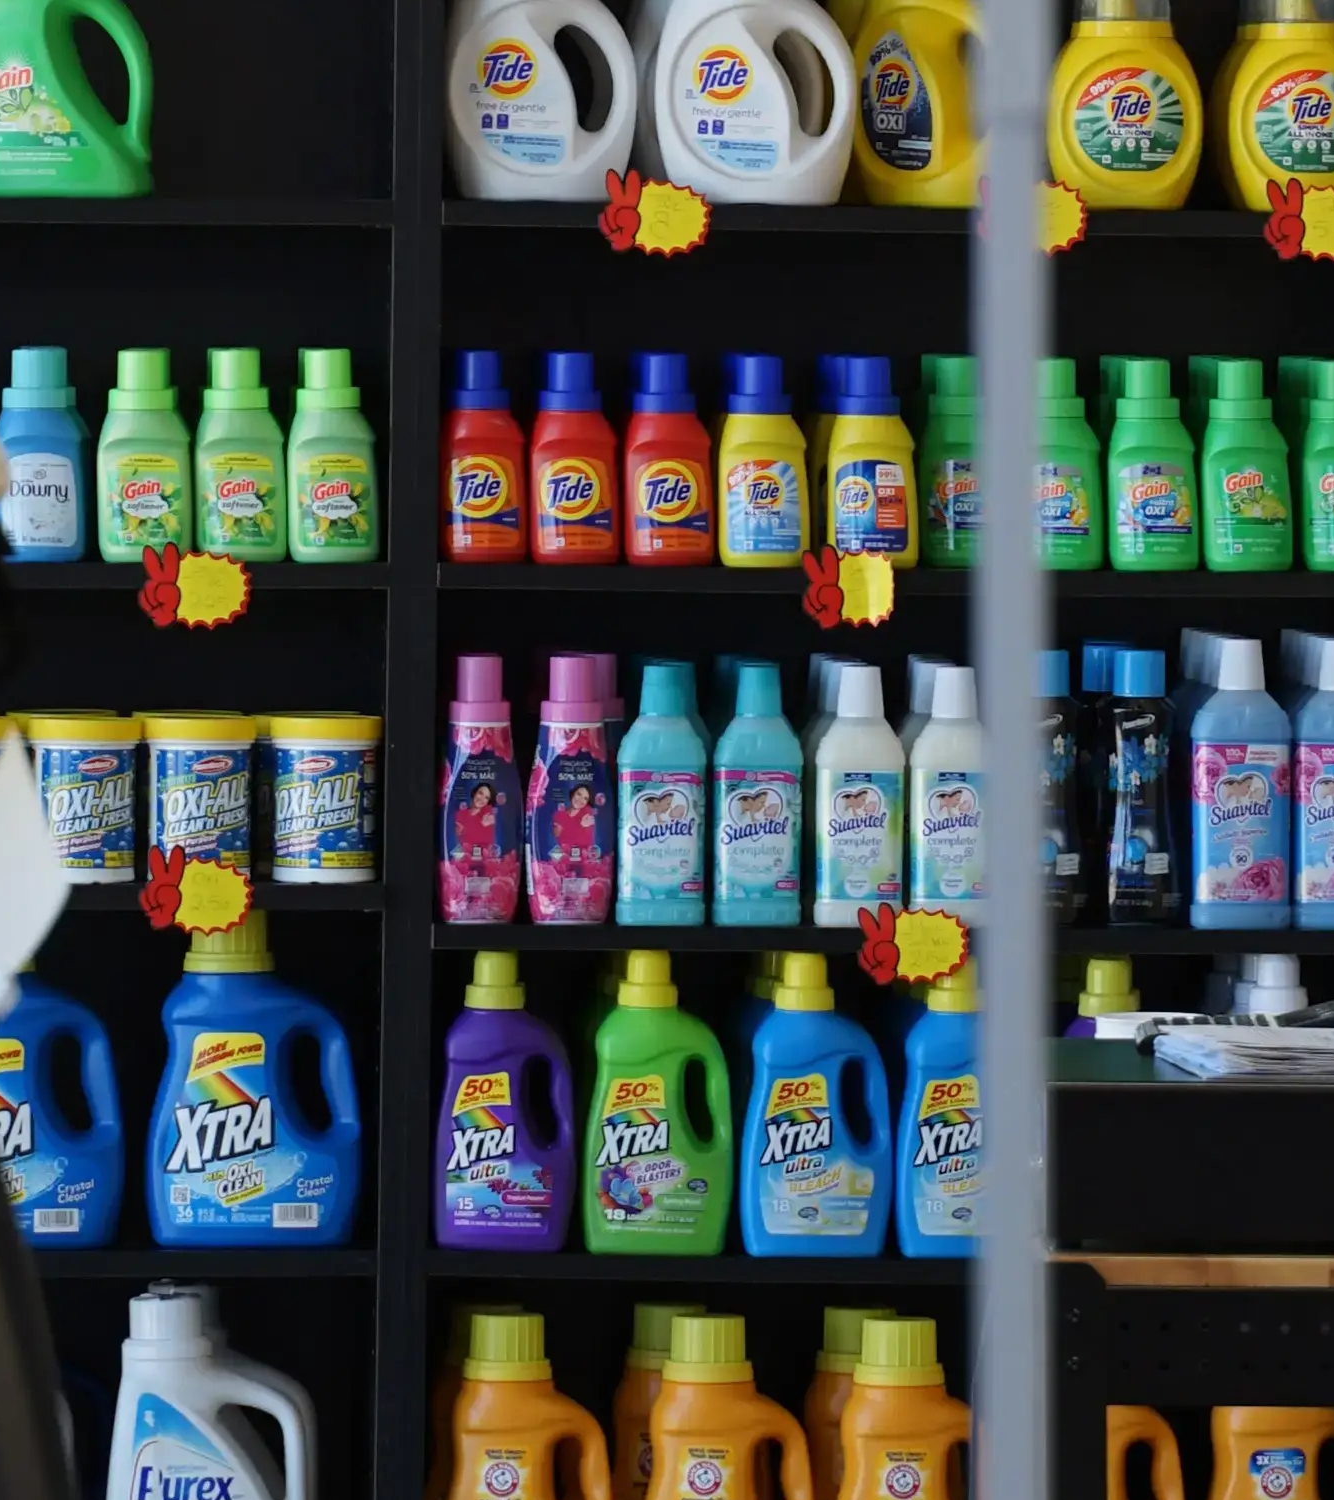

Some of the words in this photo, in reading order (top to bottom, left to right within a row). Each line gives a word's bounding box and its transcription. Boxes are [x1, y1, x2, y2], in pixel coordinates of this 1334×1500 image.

[483, 54, 534, 87] Tide
[699, 60, 748, 94] Tide
[877, 72, 909, 102] Tide
[476, 102, 497, 112] free
[511, 103, 546, 114] gentle
[727, 109, 761, 119] gentle
[1112, 94, 1151, 122] Tide
[1293, 96, 1332, 123] Tide
[877, 113, 902, 130] OXI
[124, 479, 161, 499] Gain
[218, 479, 255, 497] Gain
[313, 480, 351, 500] Gain
[454, 473, 501, 508] Tide
[1132, 482, 1169, 500] Gain
[1223, 472, 1263, 491] Gain
[10, 482, 71, 504] Downy
[546, 475, 593, 508] Tide
[643, 477, 691, 509] Tide
[748, 483, 780, 504] Tide
[842, 489, 868, 506] Tide
[461, 772, 476, 781] 50%
[53, 776, 131, 821] OXI-ALL
[168, 777, 246, 821] OXI-ALL
[318, 810, 355, 827] FRESH
[1211, 799, 1271, 826] Suavitel
[628, 818, 694, 846] Suavitel
[721, 816, 789, 845] Suavitel
[828, 813, 886, 835] Suavitel
[923, 812, 979, 834] Suavitel
[832, 837, 881, 847] complete
[928, 837, 977, 846] complete
[196, 1042, 228, 1061] MORE
[463, 1079, 504, 1096] 50%
[617, 1081, 658, 1099] 50%
[778, 1081, 821, 1100] 50%
[931, 1083, 974, 1101] 50%
[167, 1098, 275, 1172] XTRA
[596, 1121, 669, 1167] XTRA
[761, 1118, 831, 1165] XTRA
[914, 1119, 983, 1166] XTRA
[447, 1125, 515, 1171] XTRA
[227, 1161, 253, 1179] OXI
[470, 1163, 506, 1180] ultra
[645, 1161, 671, 1172] ODOR
[785, 1158, 822, 1173] ultra
[939, 1159, 975, 1174] ultra
[218, 1172, 263, 1199] CLEAN
[296, 1175, 333, 1189] Crystal
[636, 1168, 682, 1184] BLASTERS
[789, 1170, 842, 1191] BLEACH
[58, 1179, 94, 1193] Crystal
[176, 1206, 193, 1218] 36
[457, 1198, 473, 1210] 15
[772, 1201, 790, 1212] 18
[926, 1201, 943, 1212] 18
[605, 1209, 625, 1220] 18
